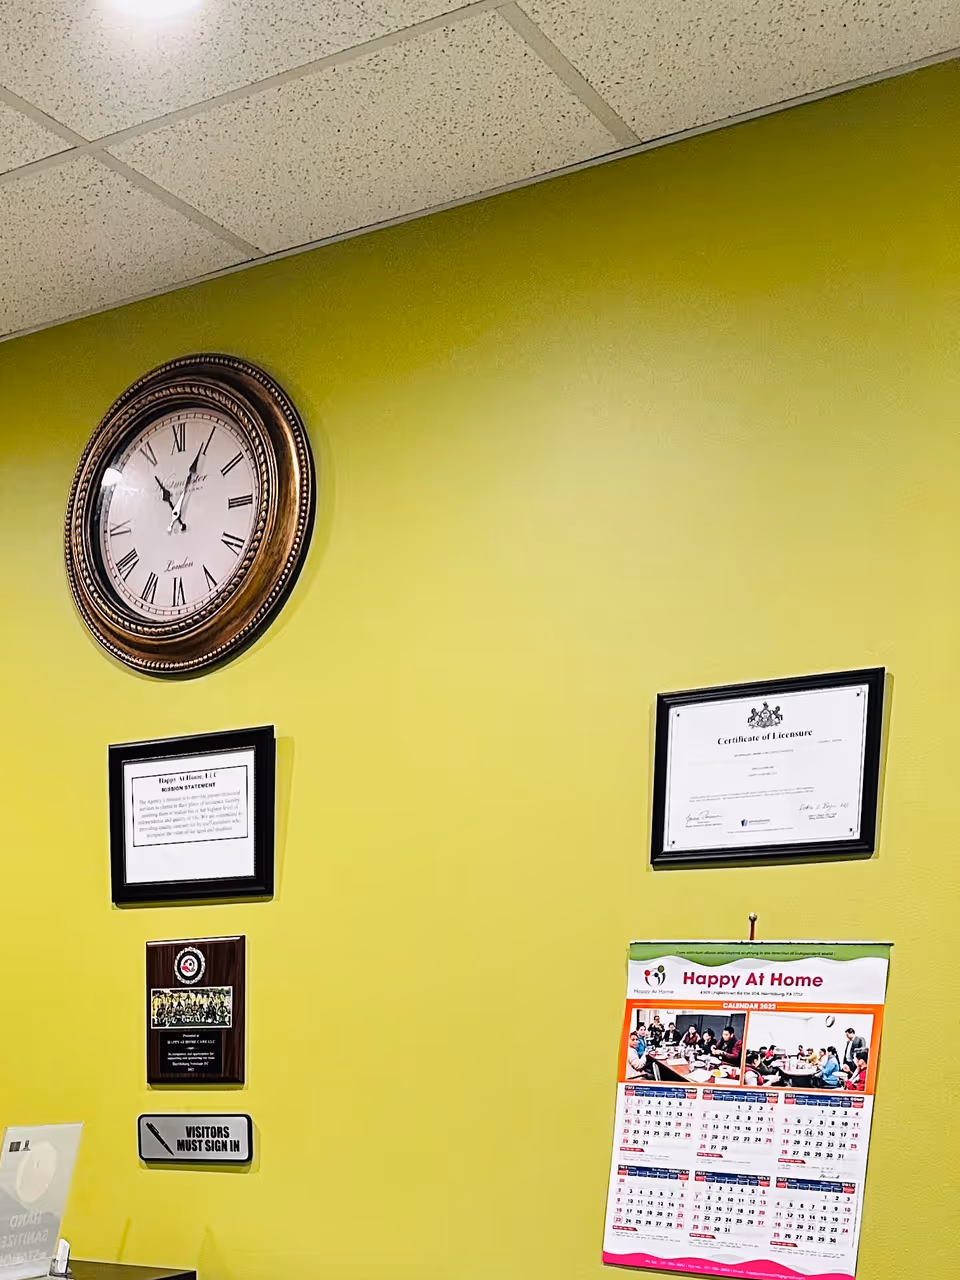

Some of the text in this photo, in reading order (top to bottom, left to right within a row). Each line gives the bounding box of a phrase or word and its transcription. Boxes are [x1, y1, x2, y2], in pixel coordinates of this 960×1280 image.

[171, 423, 186, 455] XII
[220, 452, 244, 476] II
[228, 494, 253, 509] III
[116, 547, 139, 582] VIII
[164, 556, 193, 573] London
[203, 564, 218, 591] V
[140, 572, 158, 604] VII
[172, 576, 186, 607] VI
[718, 736, 760, 745] Certificate
[773, 730, 812, 739] Licensure
[683, 972, 824, 988] Happy At Home
[186, 1126, 229, 1138] VISITORS
[177, 1140, 239, 1152] MUST SIGN IN
